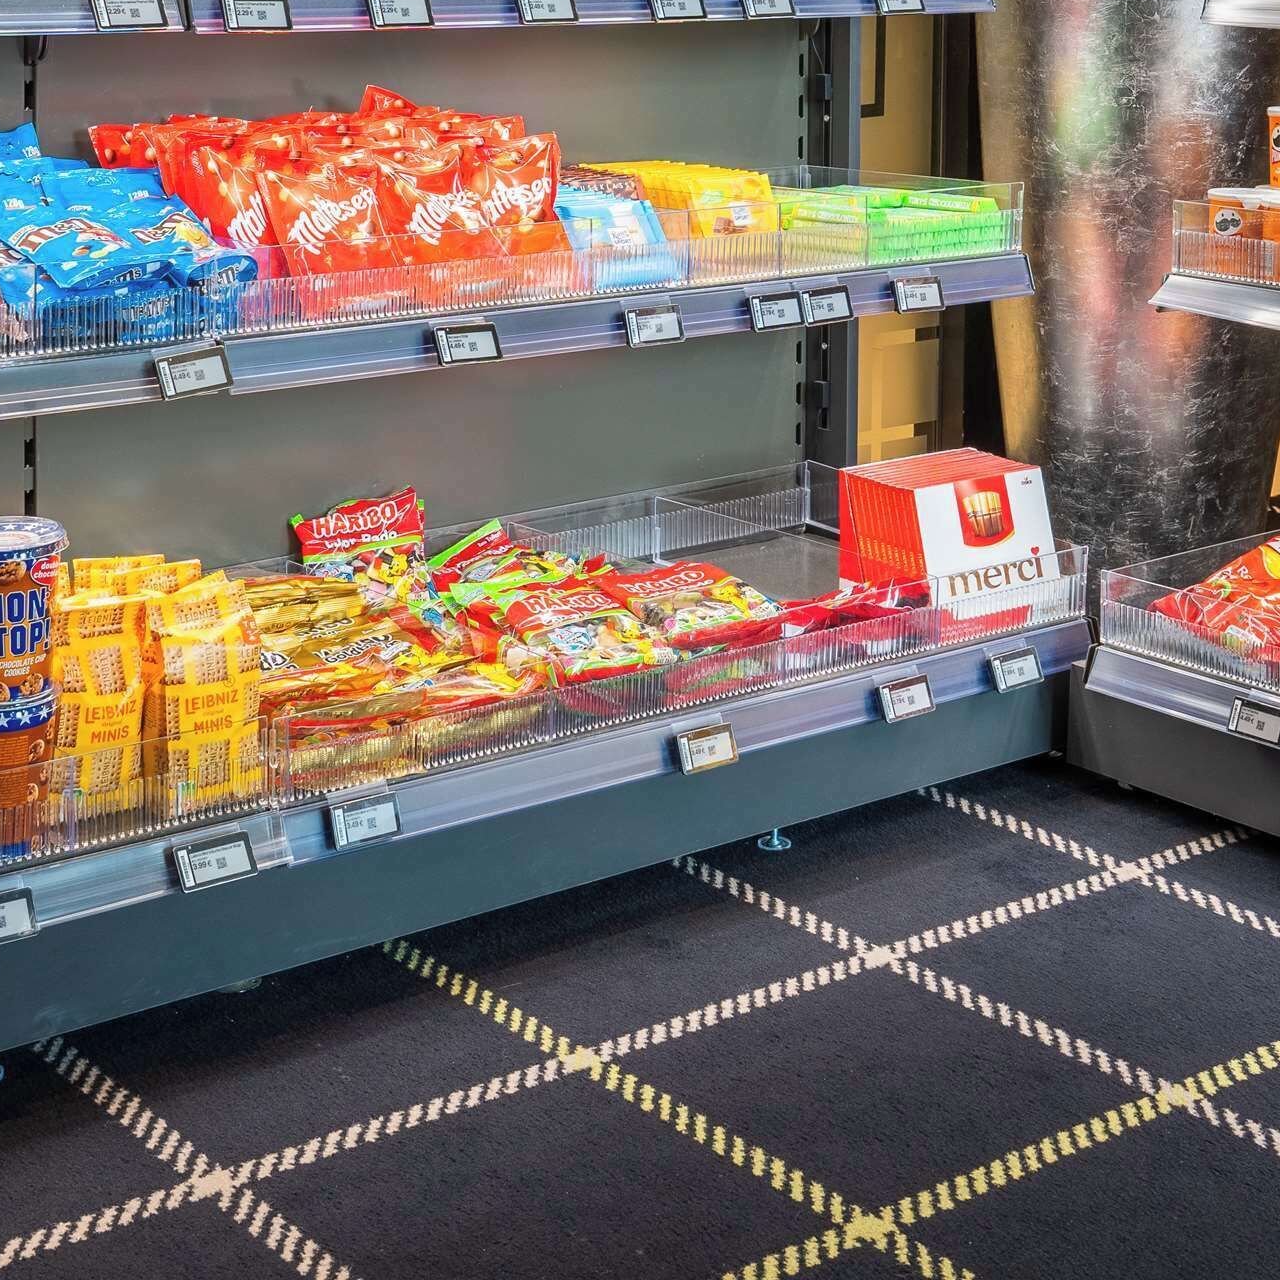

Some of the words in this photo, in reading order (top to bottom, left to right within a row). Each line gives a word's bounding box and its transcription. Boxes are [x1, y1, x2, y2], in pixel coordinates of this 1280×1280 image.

[311, 499, 399, 540] HARIBO
[946, 555, 1045, 599] merci
[523, 591, 614, 615] HARIBO
[3, 665, 30, 678] COOKIES
[84, 698, 137, 724] LEIBNIZ
[184, 689, 240, 716] LEIBNIZ
[90, 726, 130, 745] MINIS
[193, 714, 233, 735] MINIS
